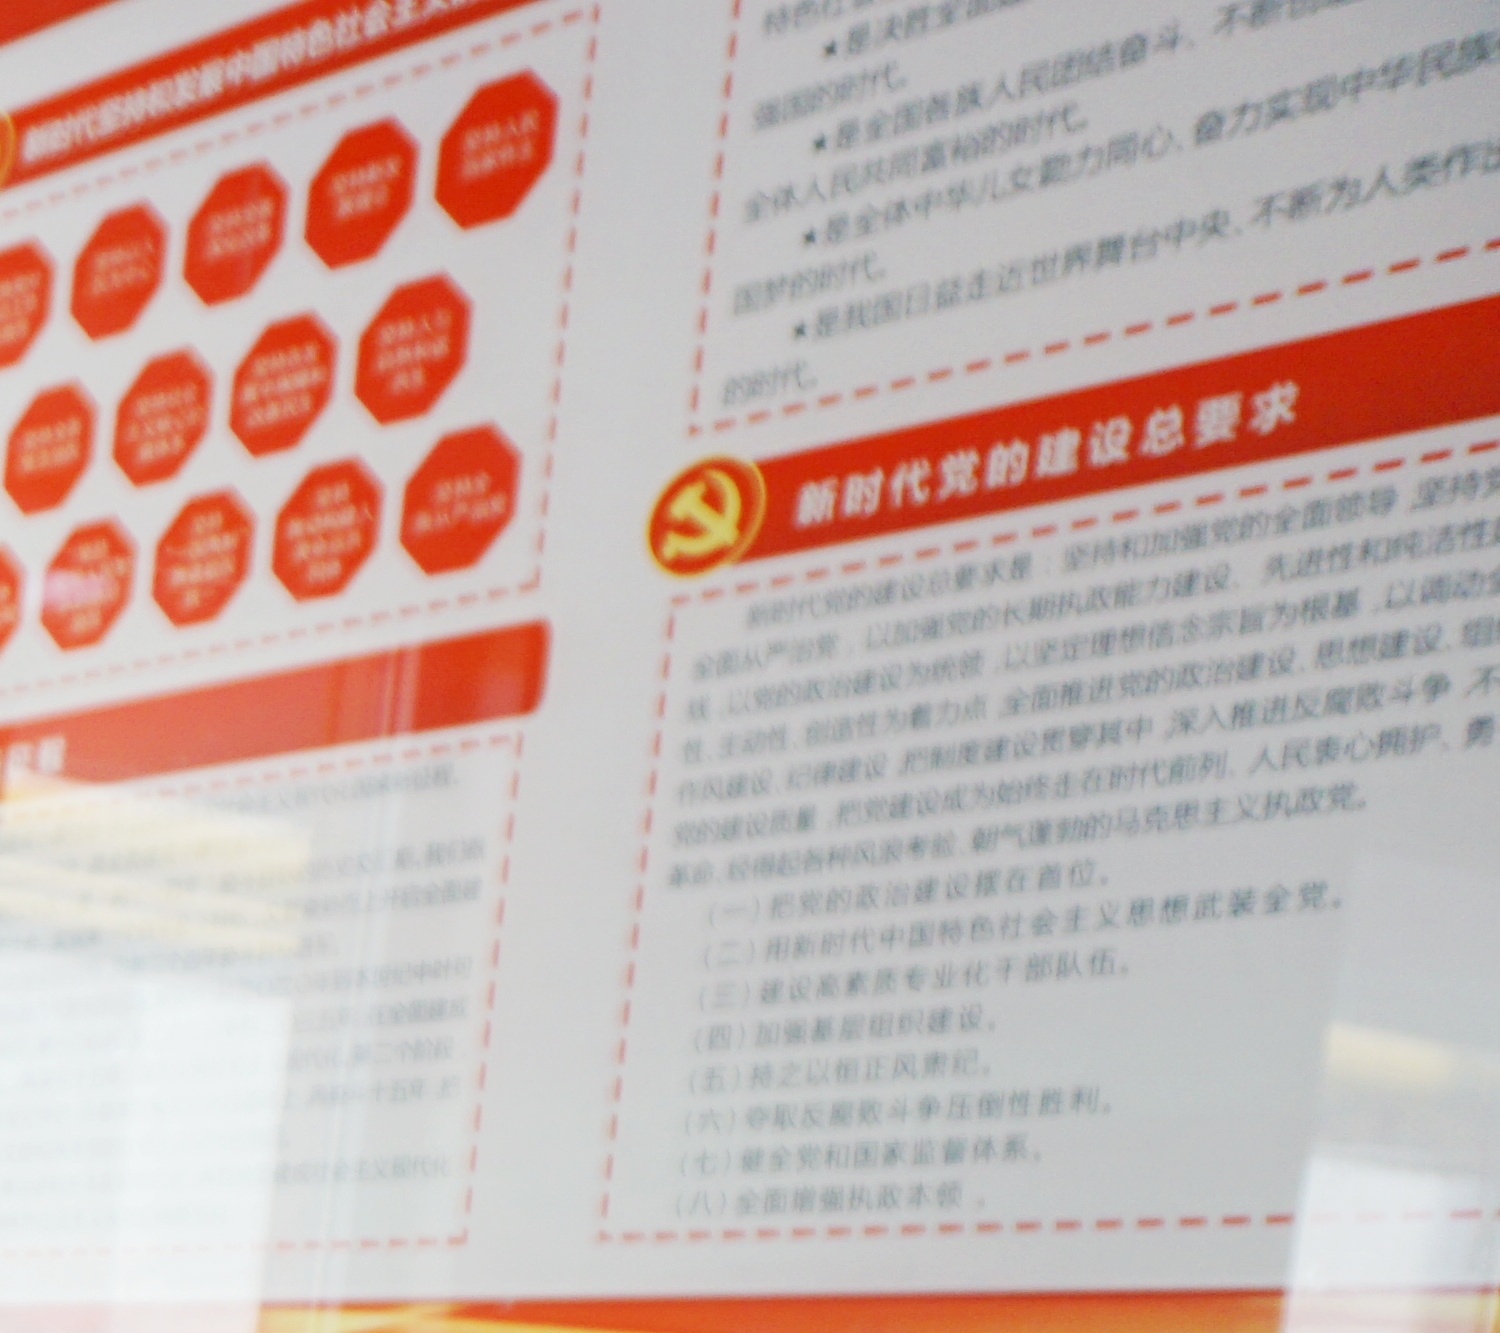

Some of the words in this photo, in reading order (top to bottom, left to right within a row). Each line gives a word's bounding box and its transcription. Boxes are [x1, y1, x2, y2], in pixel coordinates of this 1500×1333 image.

[795, 379, 1300, 530] 新时代党的建设总要求
